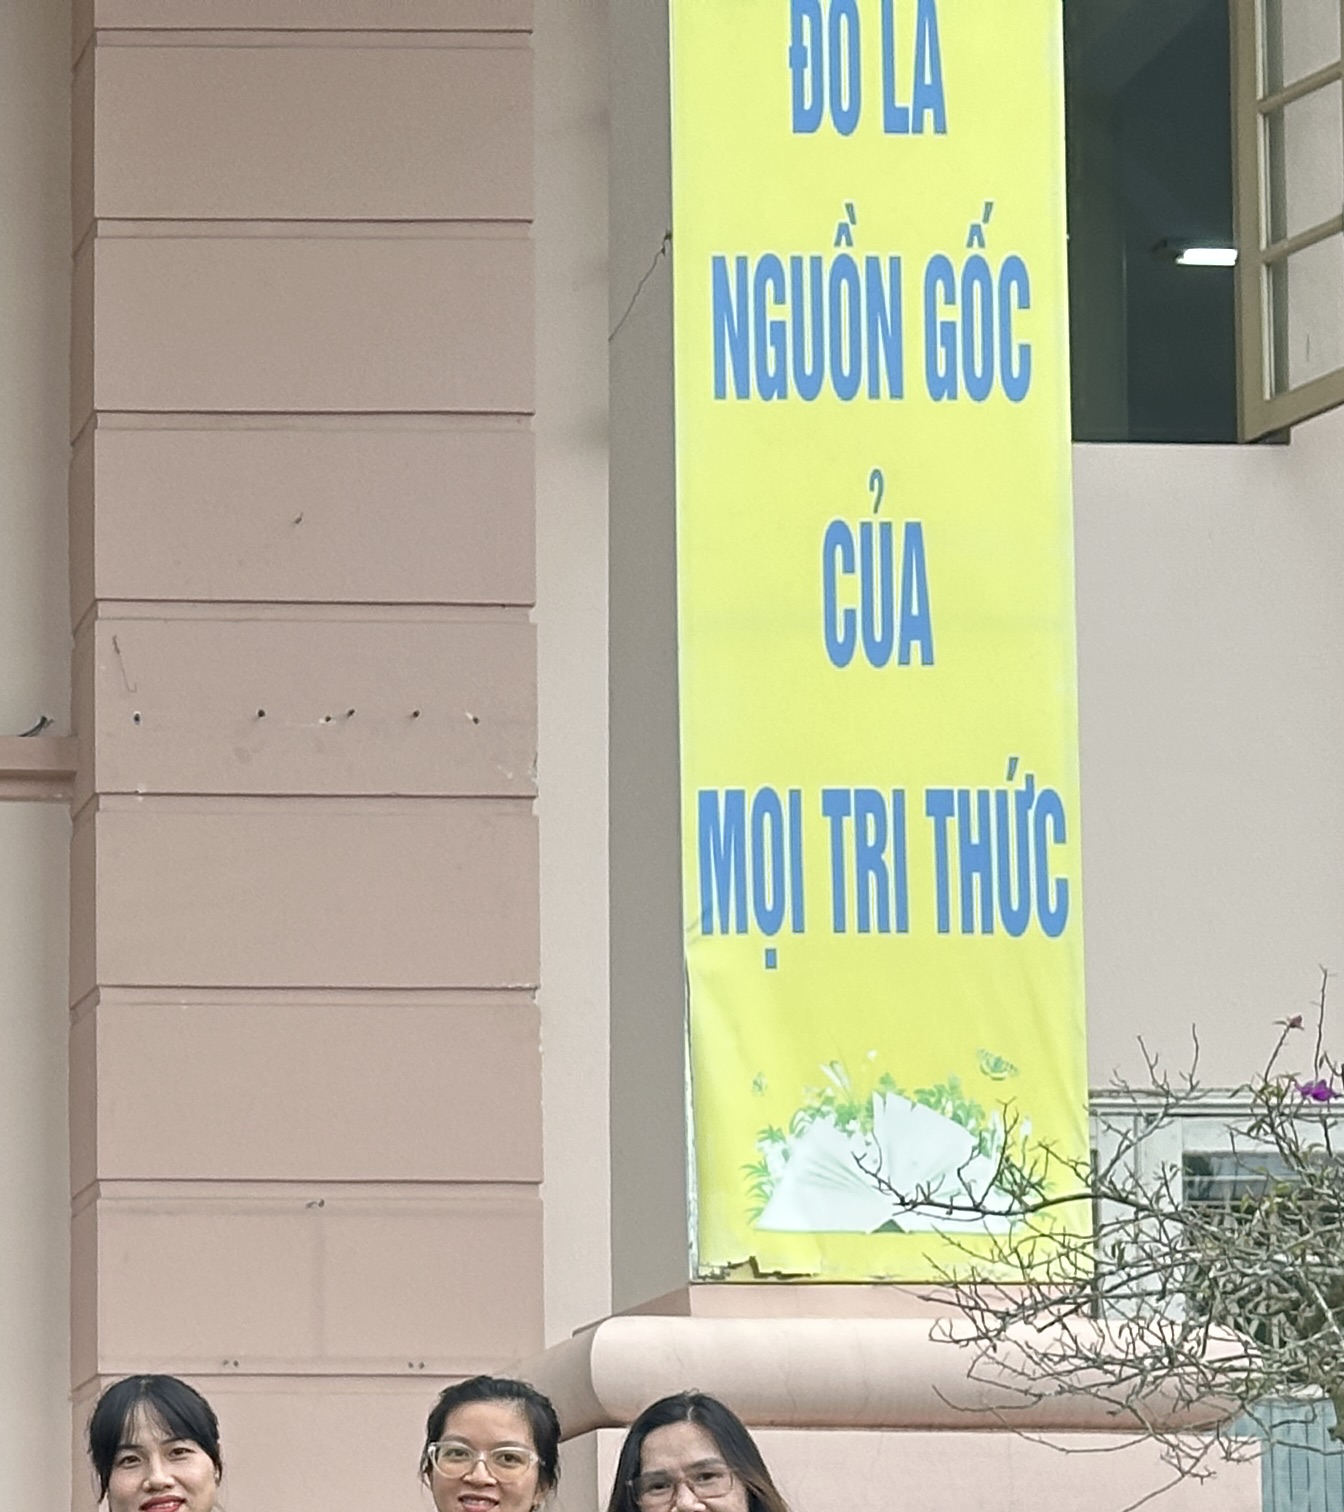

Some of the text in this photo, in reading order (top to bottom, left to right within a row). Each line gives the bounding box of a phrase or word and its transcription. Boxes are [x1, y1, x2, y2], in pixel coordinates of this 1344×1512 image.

[712, 203, 1032, 402] NGUỒN GỐC
[823, 470, 934, 667] CỦA
[698, 757, 1069, 968] MỌI TRI THỨC
